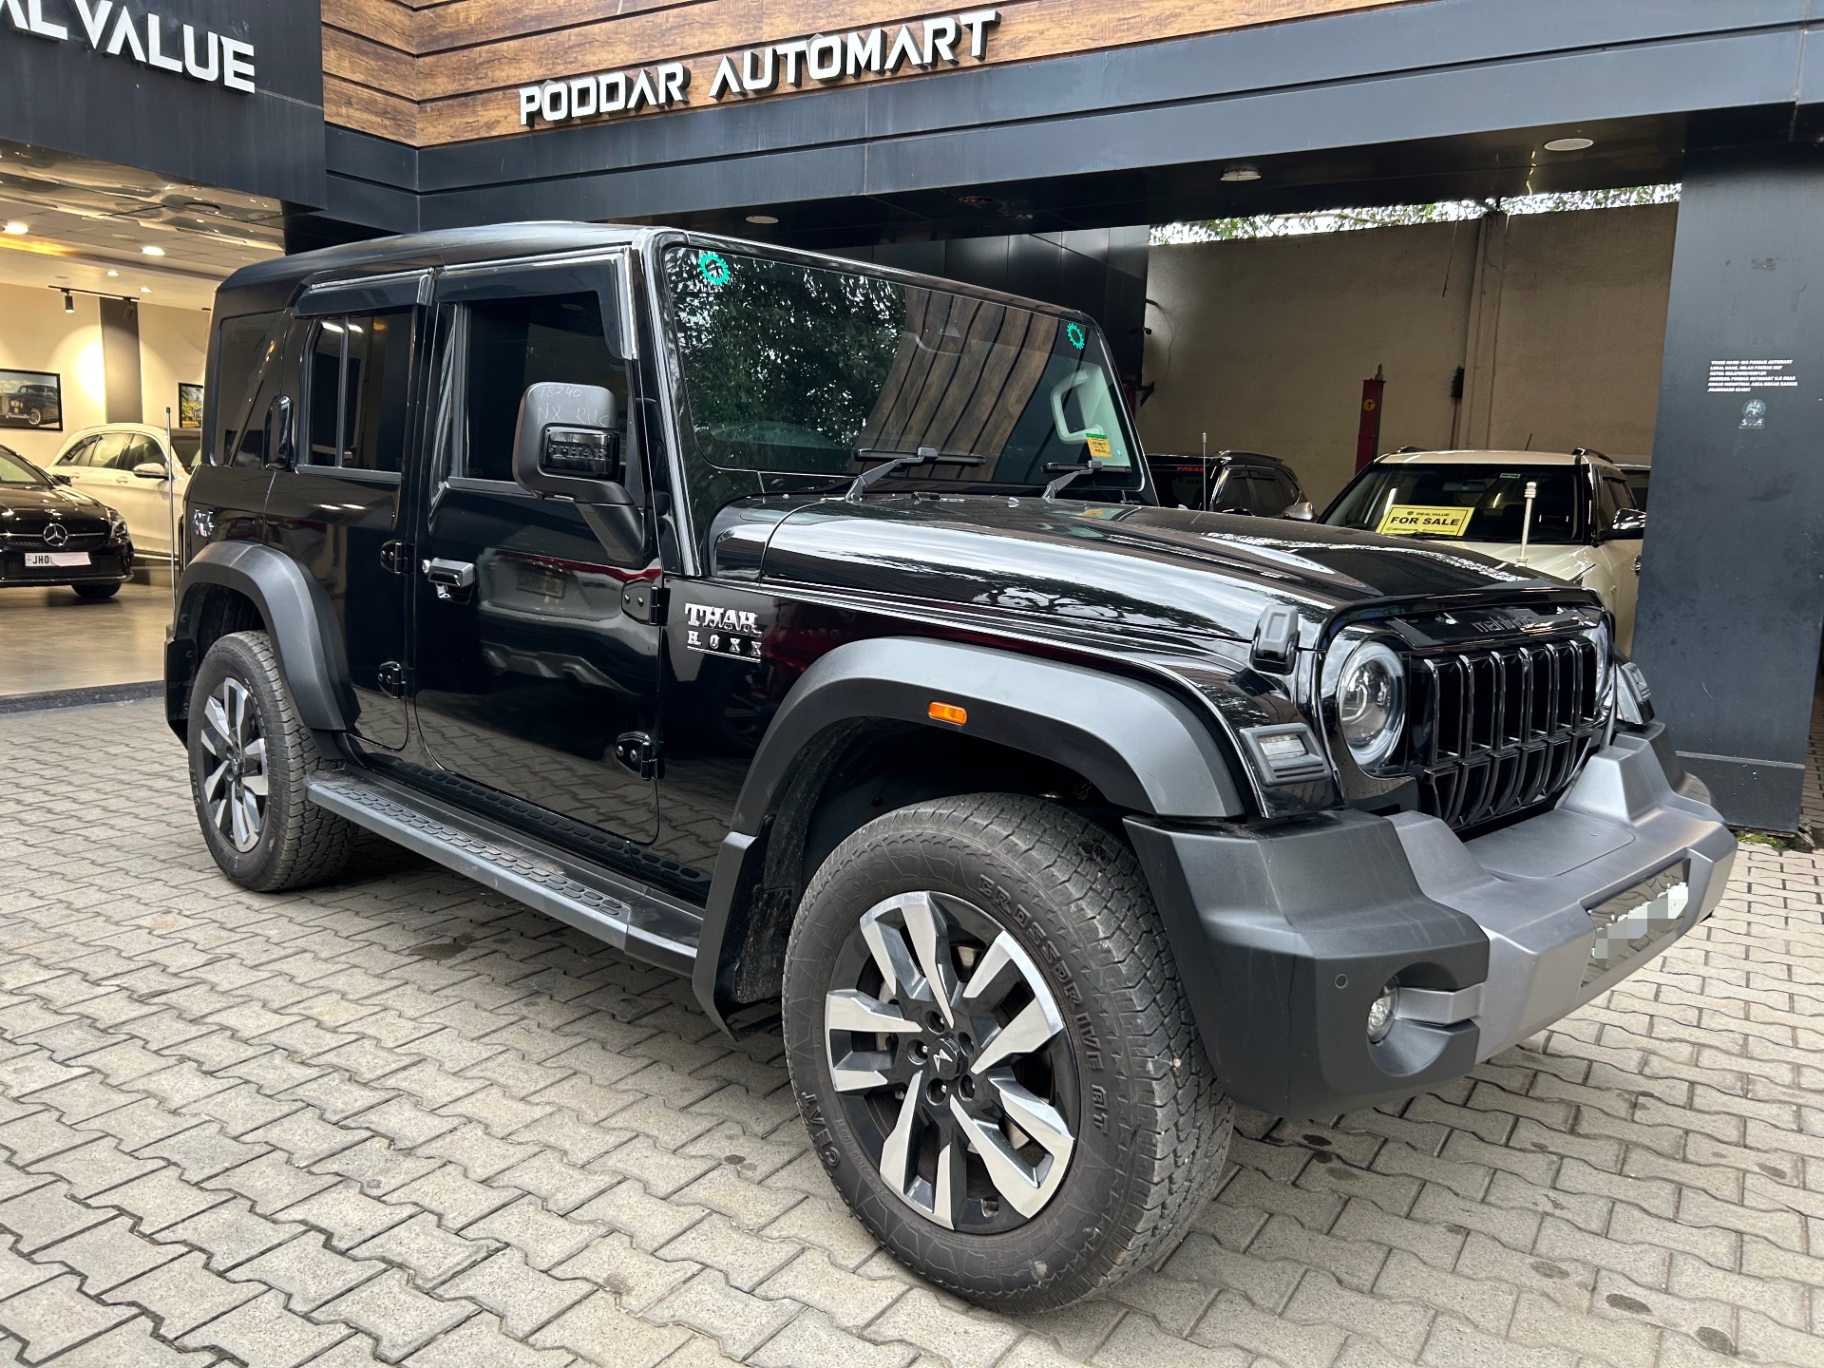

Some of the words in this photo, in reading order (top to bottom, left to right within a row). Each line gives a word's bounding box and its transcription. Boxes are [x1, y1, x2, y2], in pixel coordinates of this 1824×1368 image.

[74, 0, 256, 93] VALUE
[519, 62, 691, 127] PODDAR
[708, 9, 1001, 98] AUTOMART
[1390, 516, 1419, 525] FOR
[1422, 517, 1460, 526] SALE
[684, 602, 762, 637] THAR
[801, 1091, 840, 1167] CEAT
